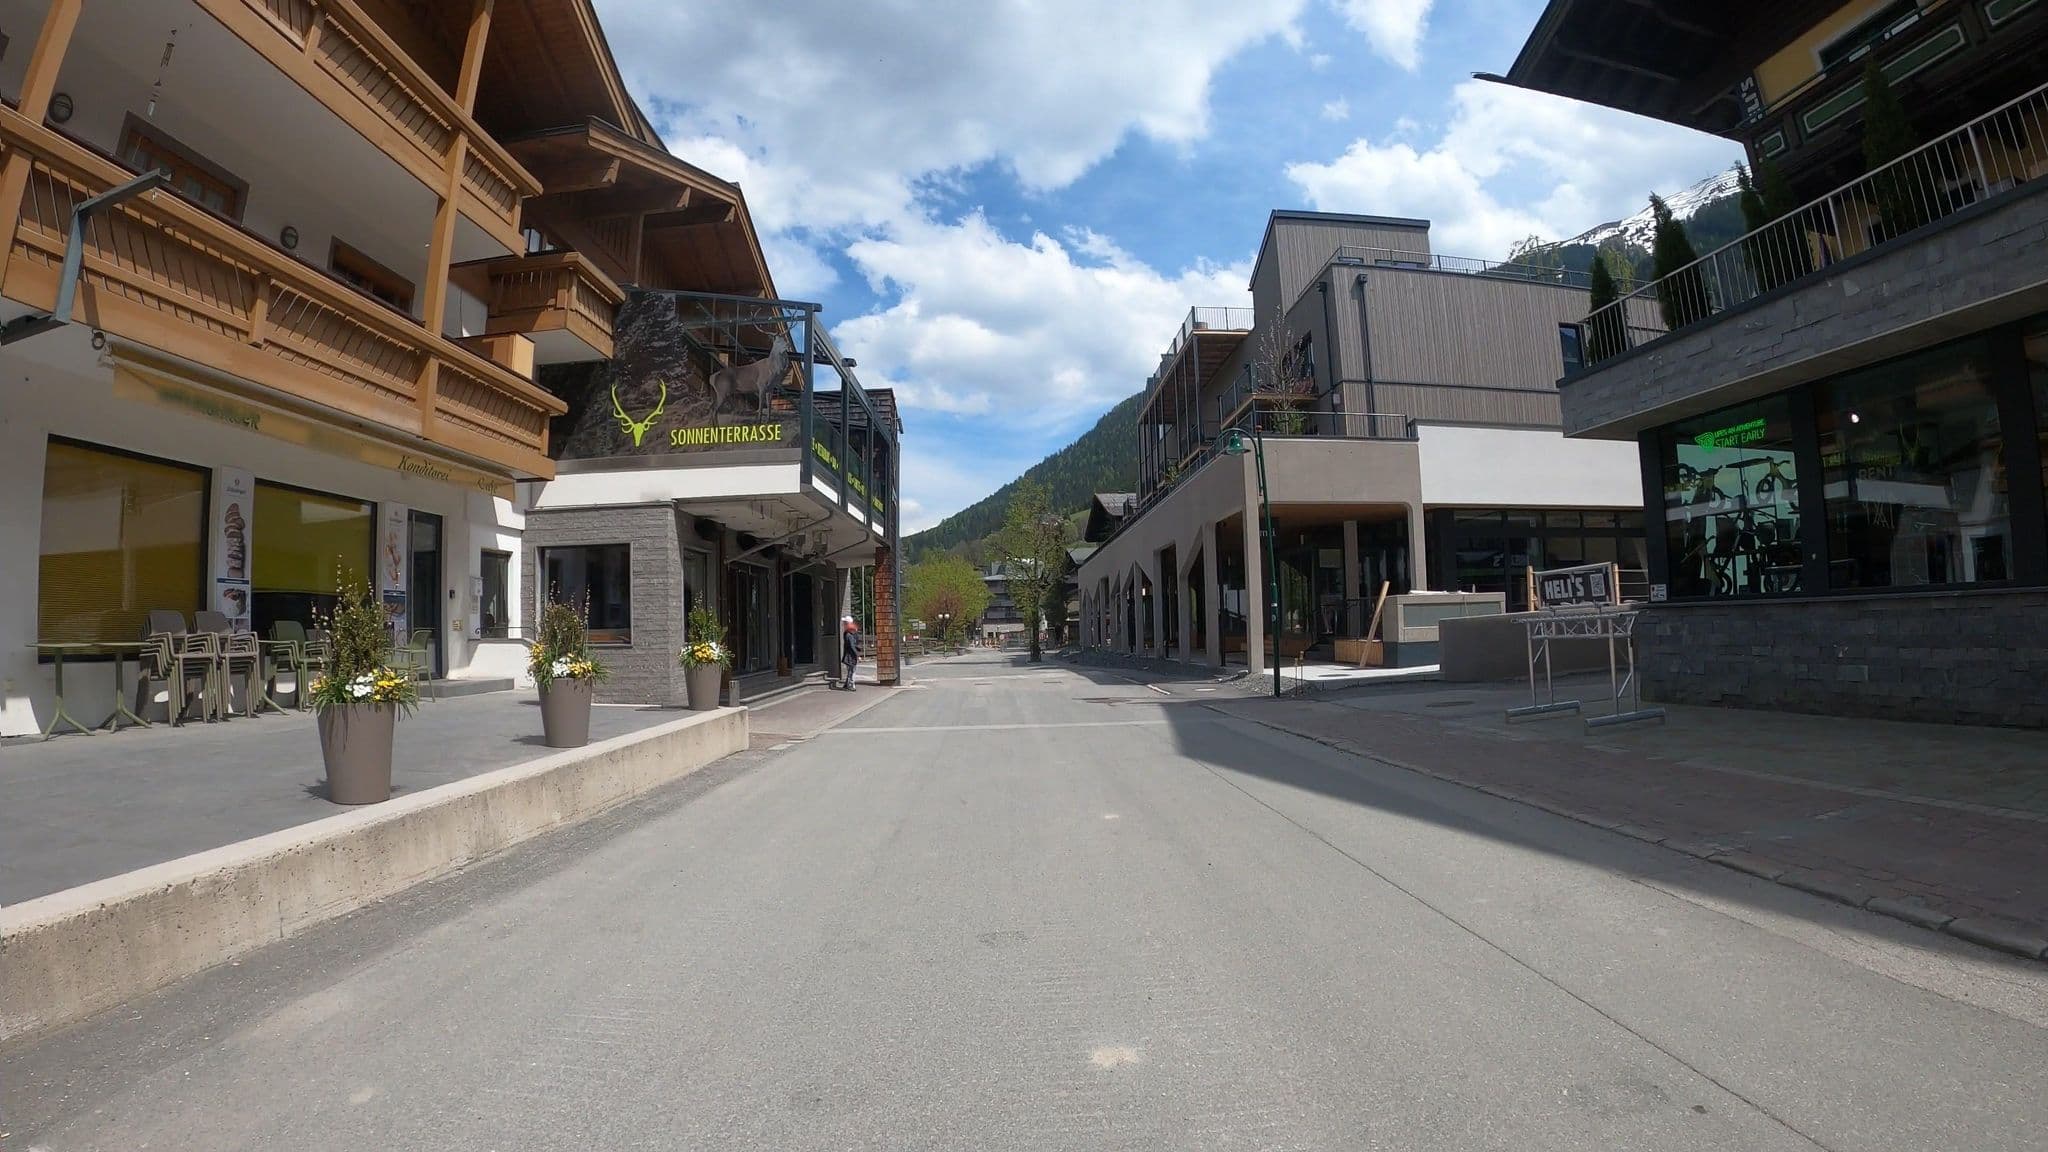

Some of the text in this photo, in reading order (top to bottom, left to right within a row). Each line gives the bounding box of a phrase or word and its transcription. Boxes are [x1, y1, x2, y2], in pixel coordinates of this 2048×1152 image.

[670, 424, 781, 446] SONNENTERRASSE
[1715, 427, 1765, 449] START EARLY
[397, 454, 452, 481] Konditorei
[1544, 575, 1585, 599] HELI'S
